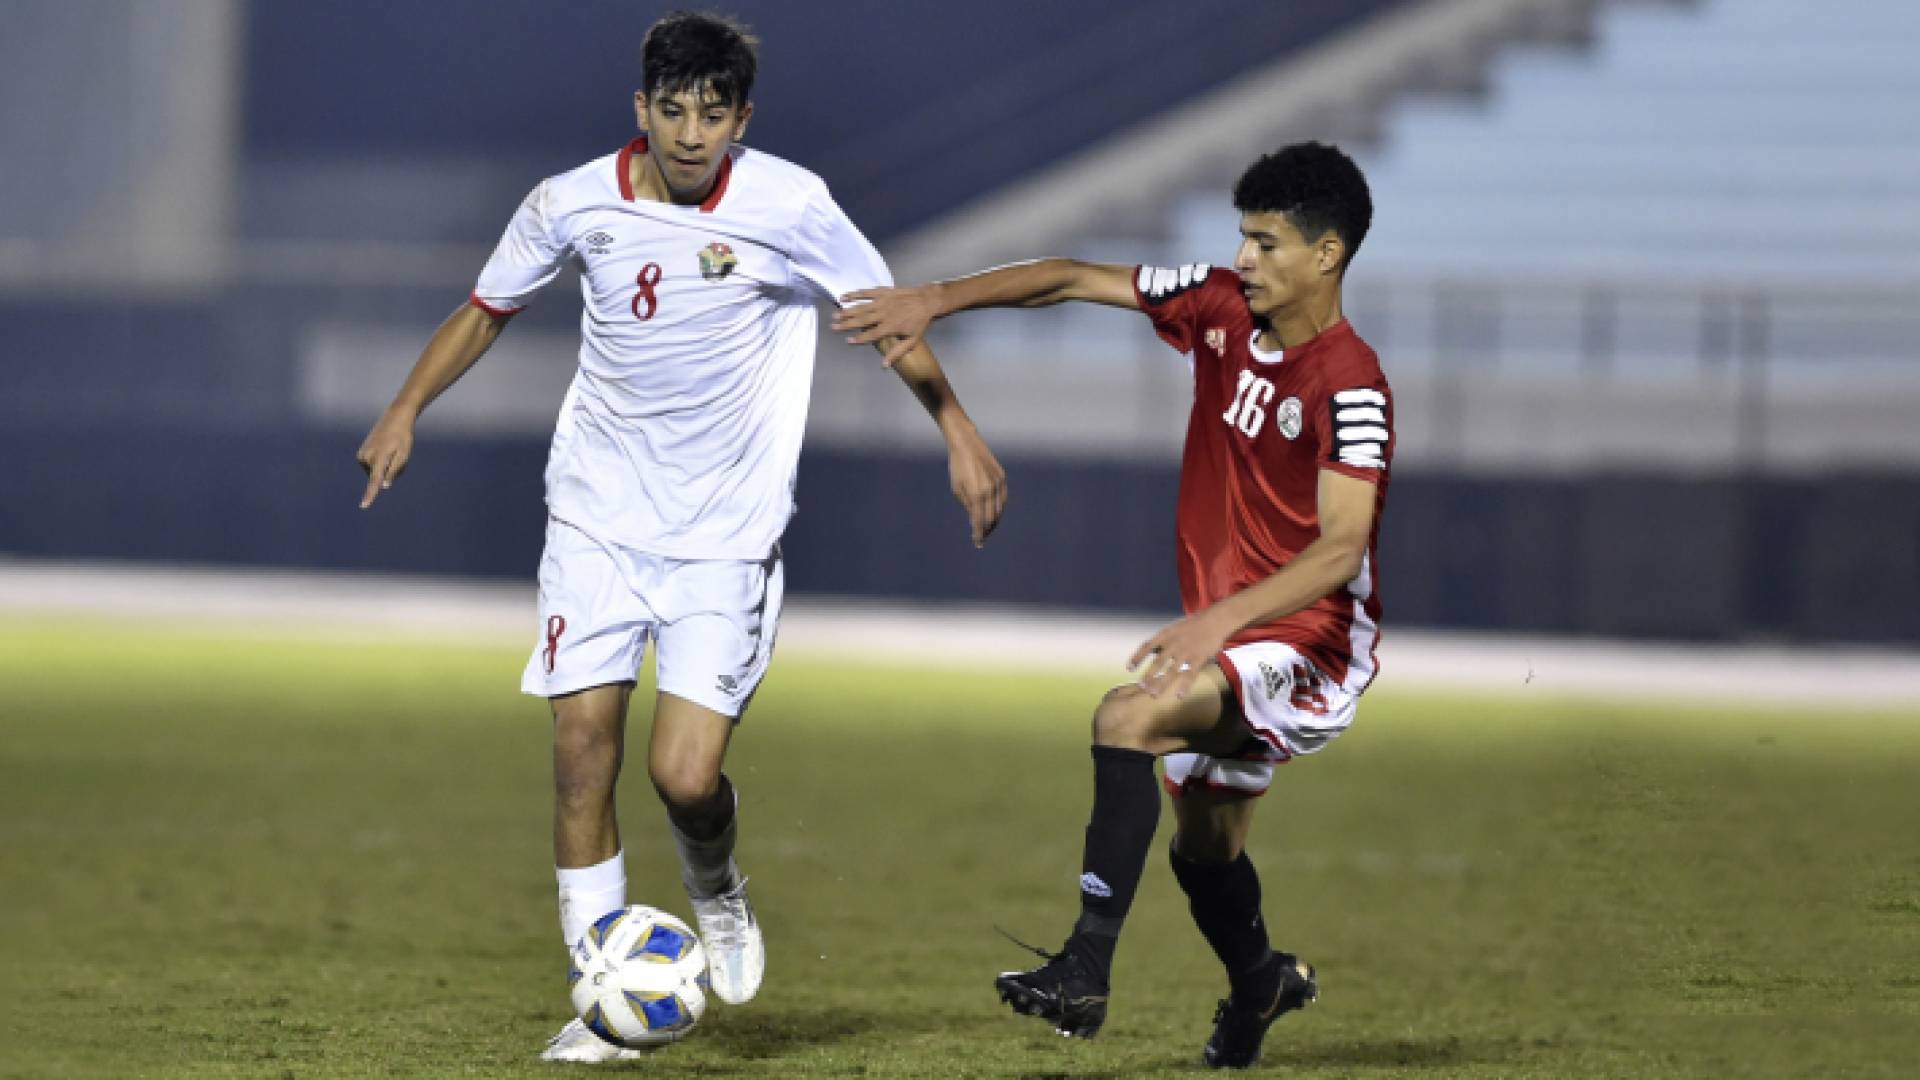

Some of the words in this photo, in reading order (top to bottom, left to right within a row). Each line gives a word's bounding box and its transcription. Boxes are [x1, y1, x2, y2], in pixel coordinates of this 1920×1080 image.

[631, 262, 662, 320] 8
[1222, 369, 1275, 438] 16
[542, 614, 567, 675] 8
